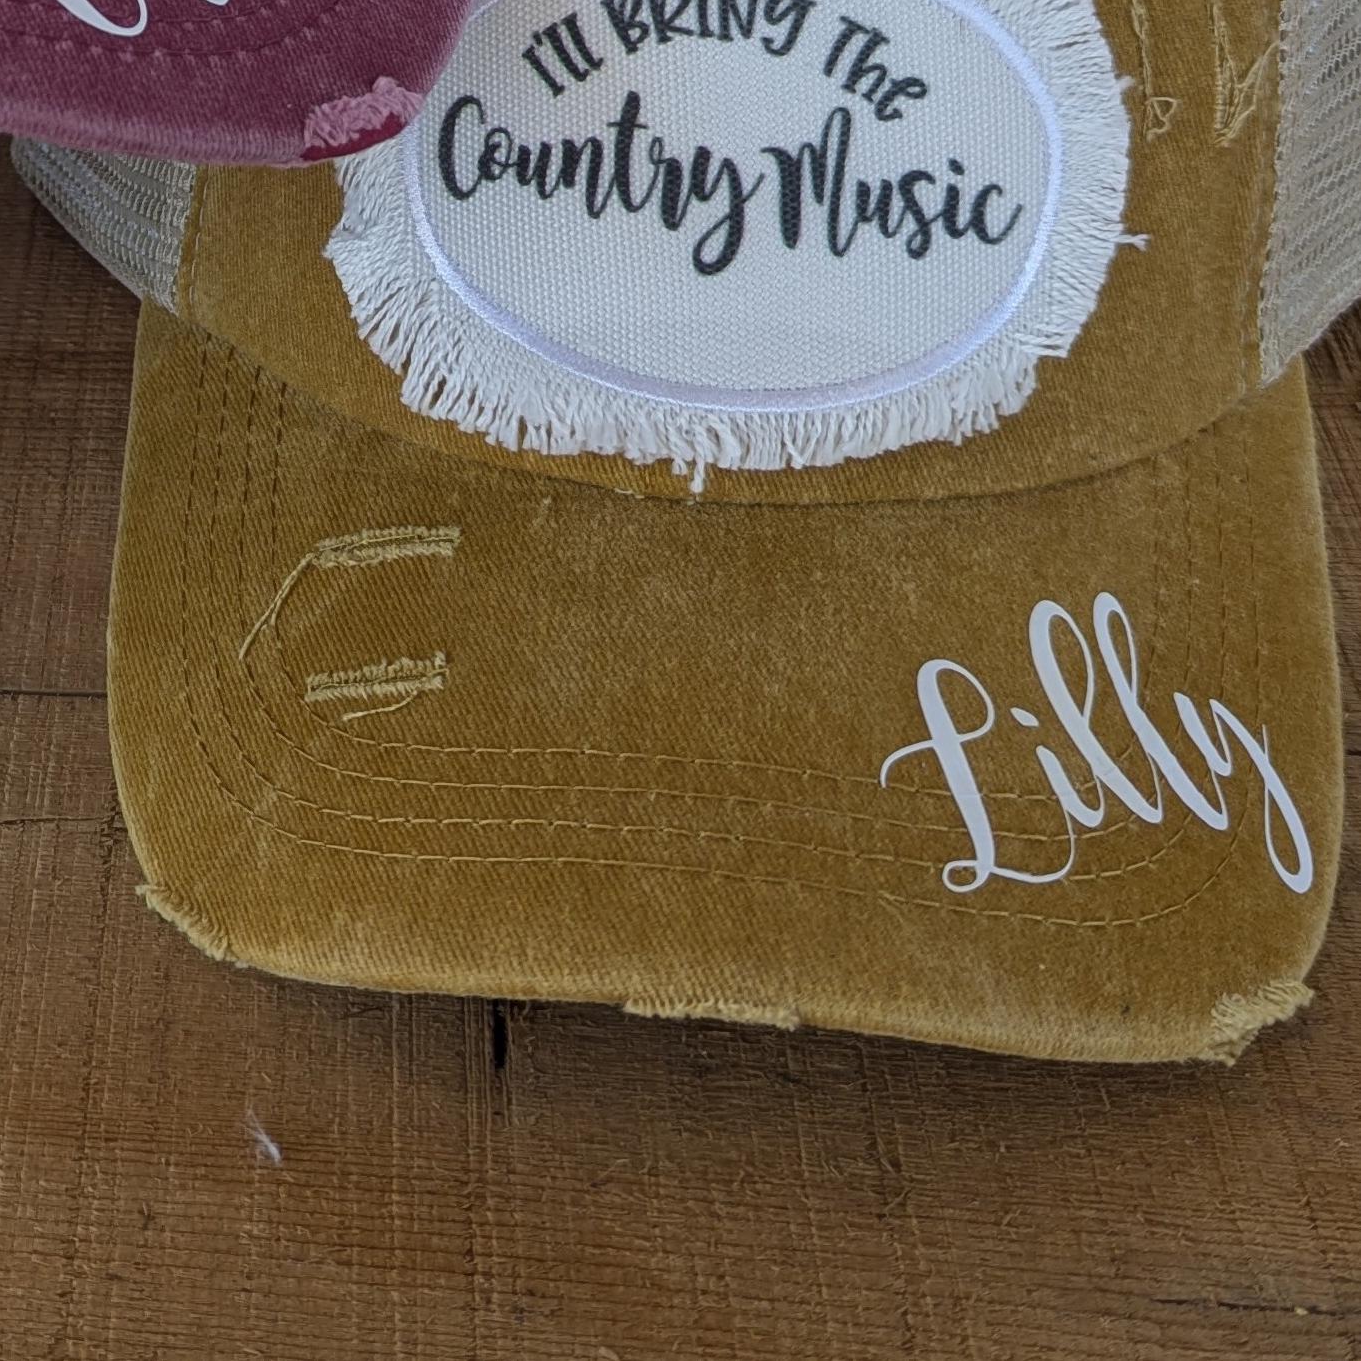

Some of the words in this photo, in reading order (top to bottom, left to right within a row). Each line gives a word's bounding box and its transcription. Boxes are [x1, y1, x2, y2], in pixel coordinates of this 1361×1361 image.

[821, 15, 928, 123] The
[438, 90, 764, 276] Country
[760, 106, 1022, 260] Music
[879, 591, 1314, 894] Lilly
